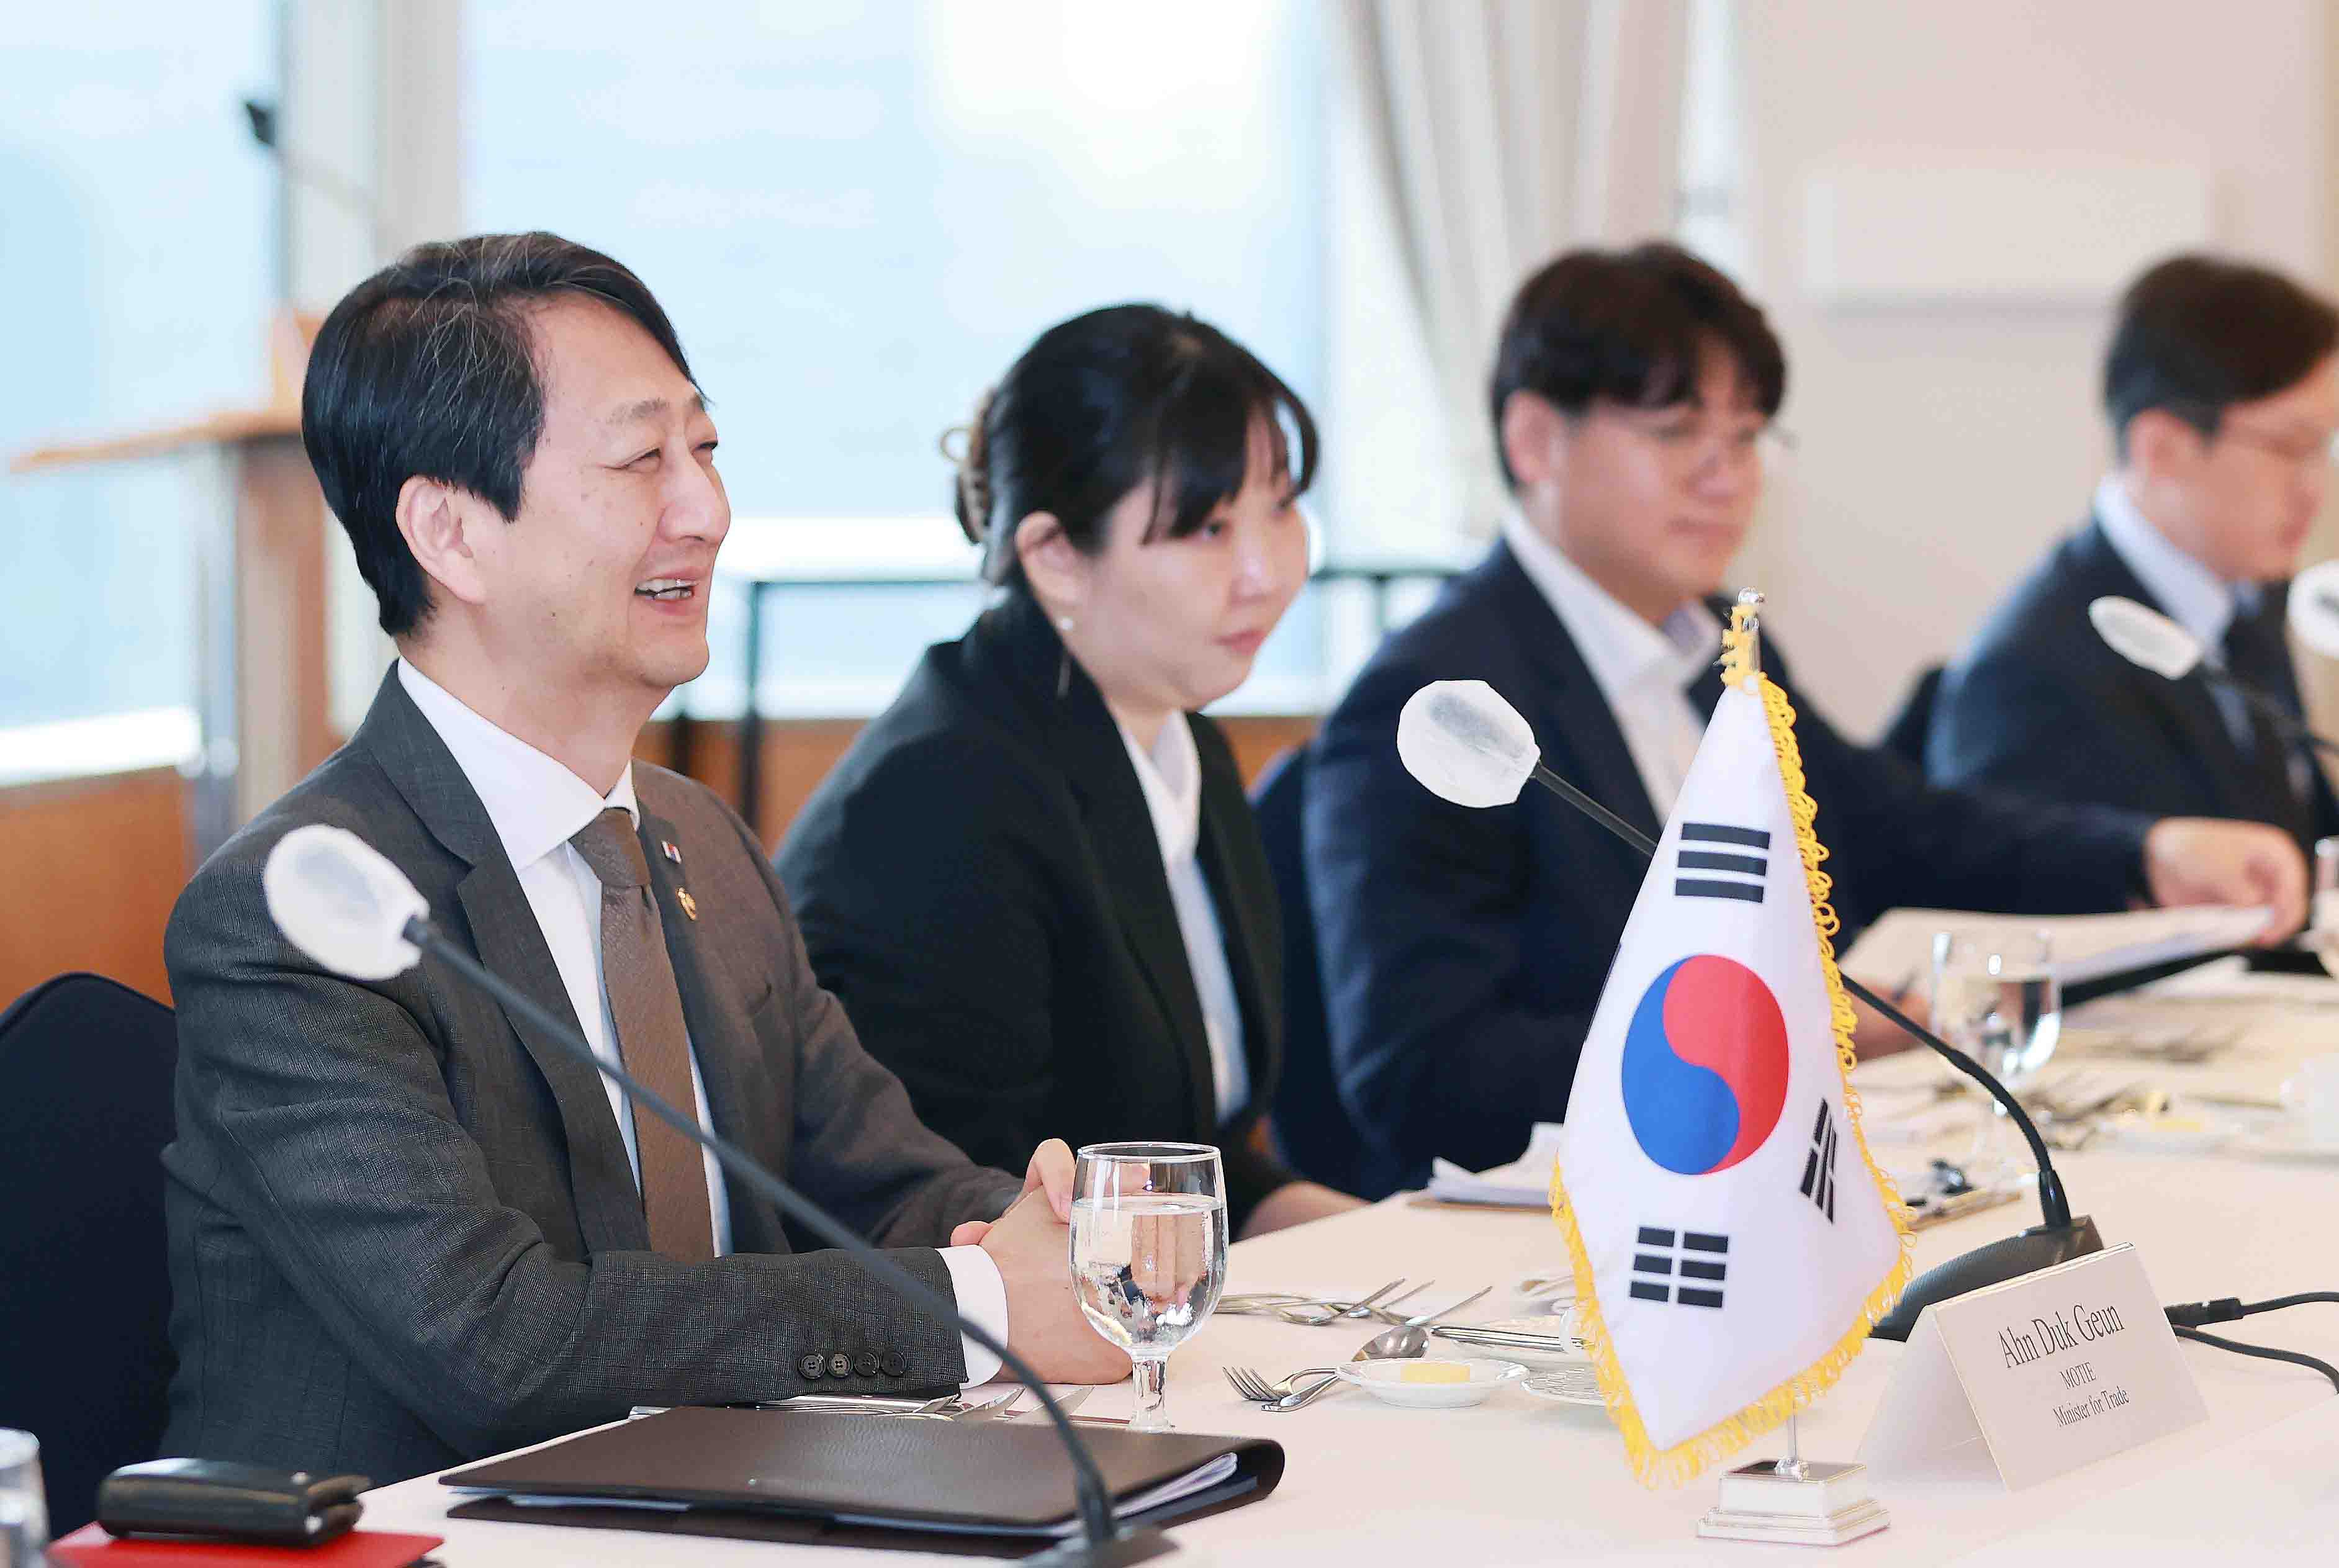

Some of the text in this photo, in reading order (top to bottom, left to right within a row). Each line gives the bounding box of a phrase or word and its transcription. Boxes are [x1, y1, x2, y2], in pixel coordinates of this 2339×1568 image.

[1997, 1303, 2126, 1369] Ahn Duk Geun
[2058, 1361, 2097, 1390] MOTIE
[2052, 1385, 2130, 1427] Minister for Trade
